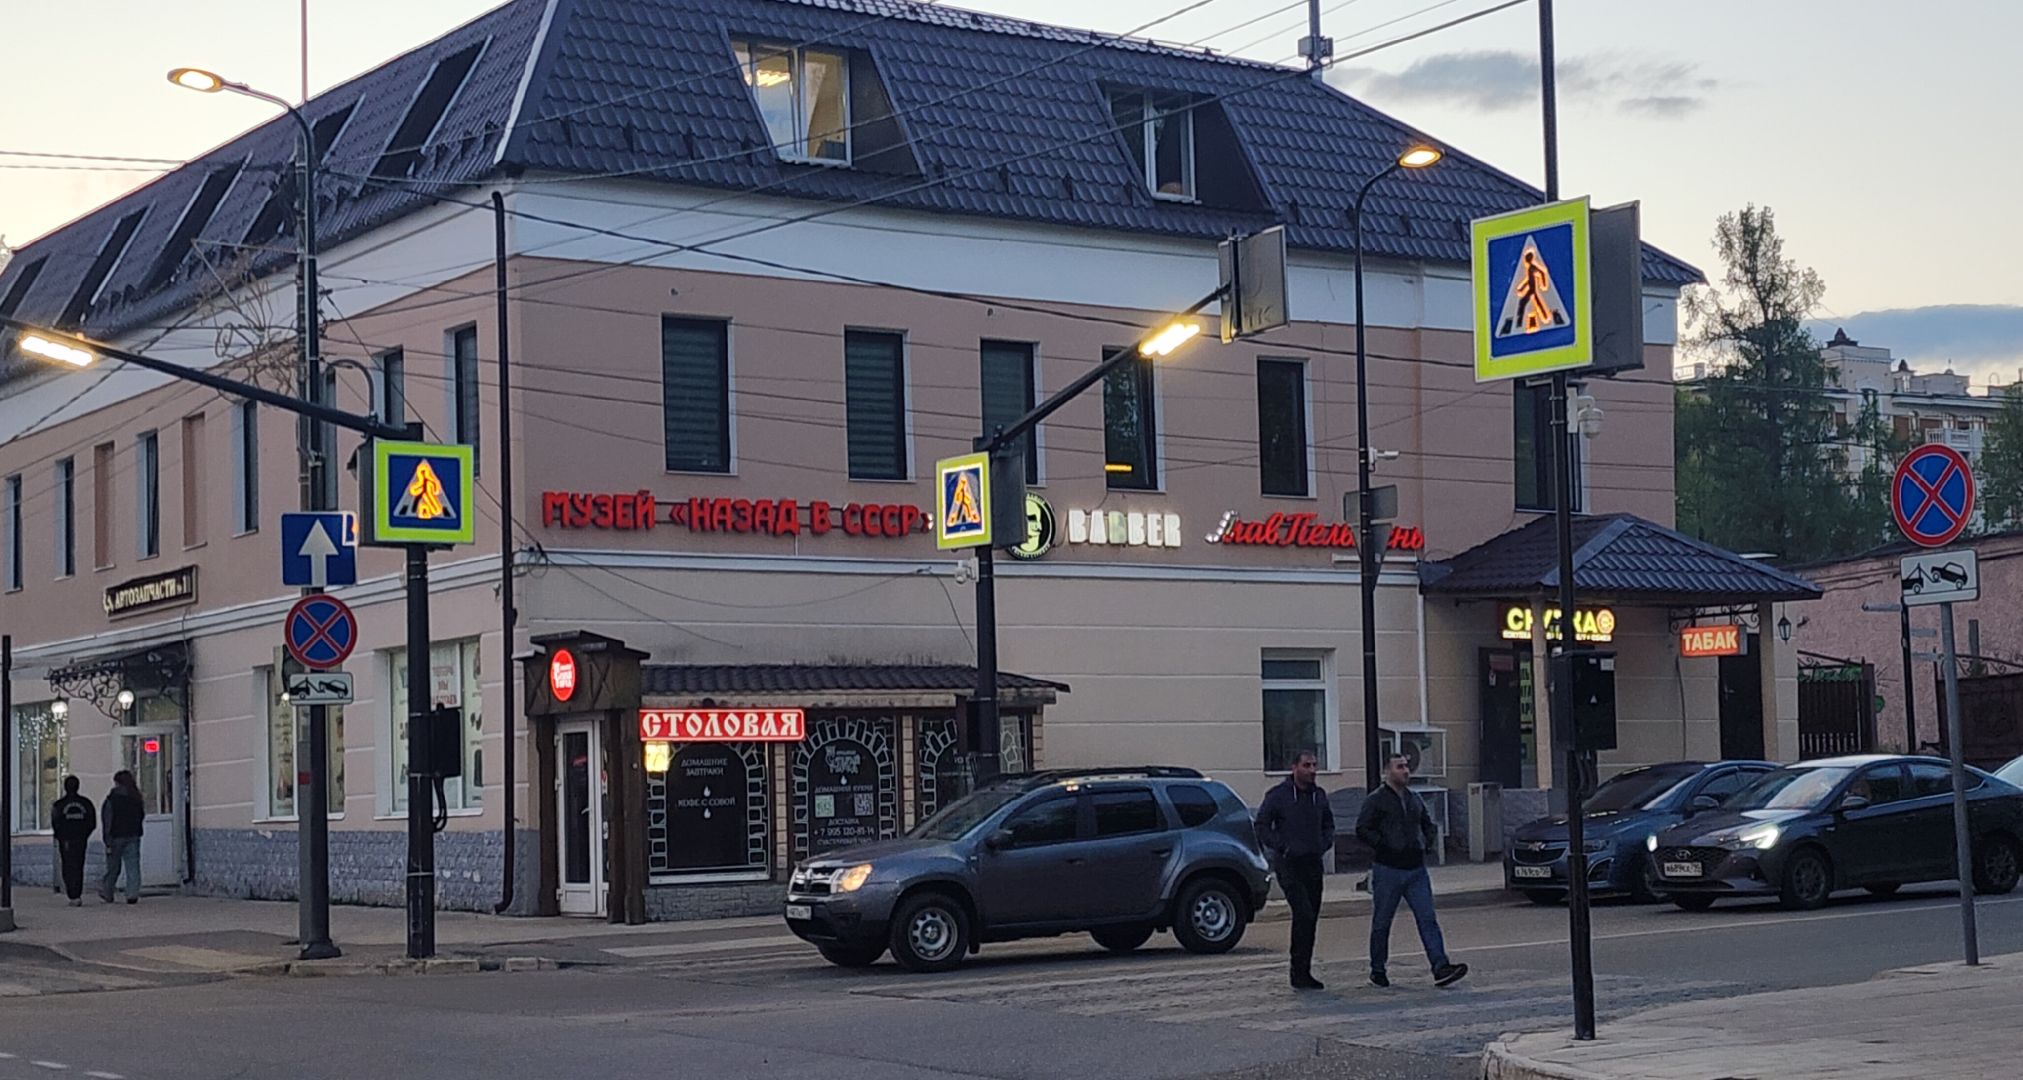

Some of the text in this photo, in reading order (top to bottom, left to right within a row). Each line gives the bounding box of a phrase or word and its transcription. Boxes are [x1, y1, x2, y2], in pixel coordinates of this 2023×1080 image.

[543, 489, 656, 530] МУЗЕЙ
[669, 497, 800, 536] «НАЗАД
[810, 500, 831, 535] В
[1068, 508, 1182, 547] BARBER
[115, 578, 176, 610] АВТОЗАПЧАСТИ
[1682, 630, 1738, 652] ТАБАК
[642, 712, 799, 738] СТОЛОВАЯ
[681, 758, 728, 768] ДОМАШНИЕ
[686, 767, 724, 777] ЗАВТРАКИ
[678, 796, 736, 808] КОФЕ С СОБОЙ
[828, 818, 860, 827] ДОСТАВКА
